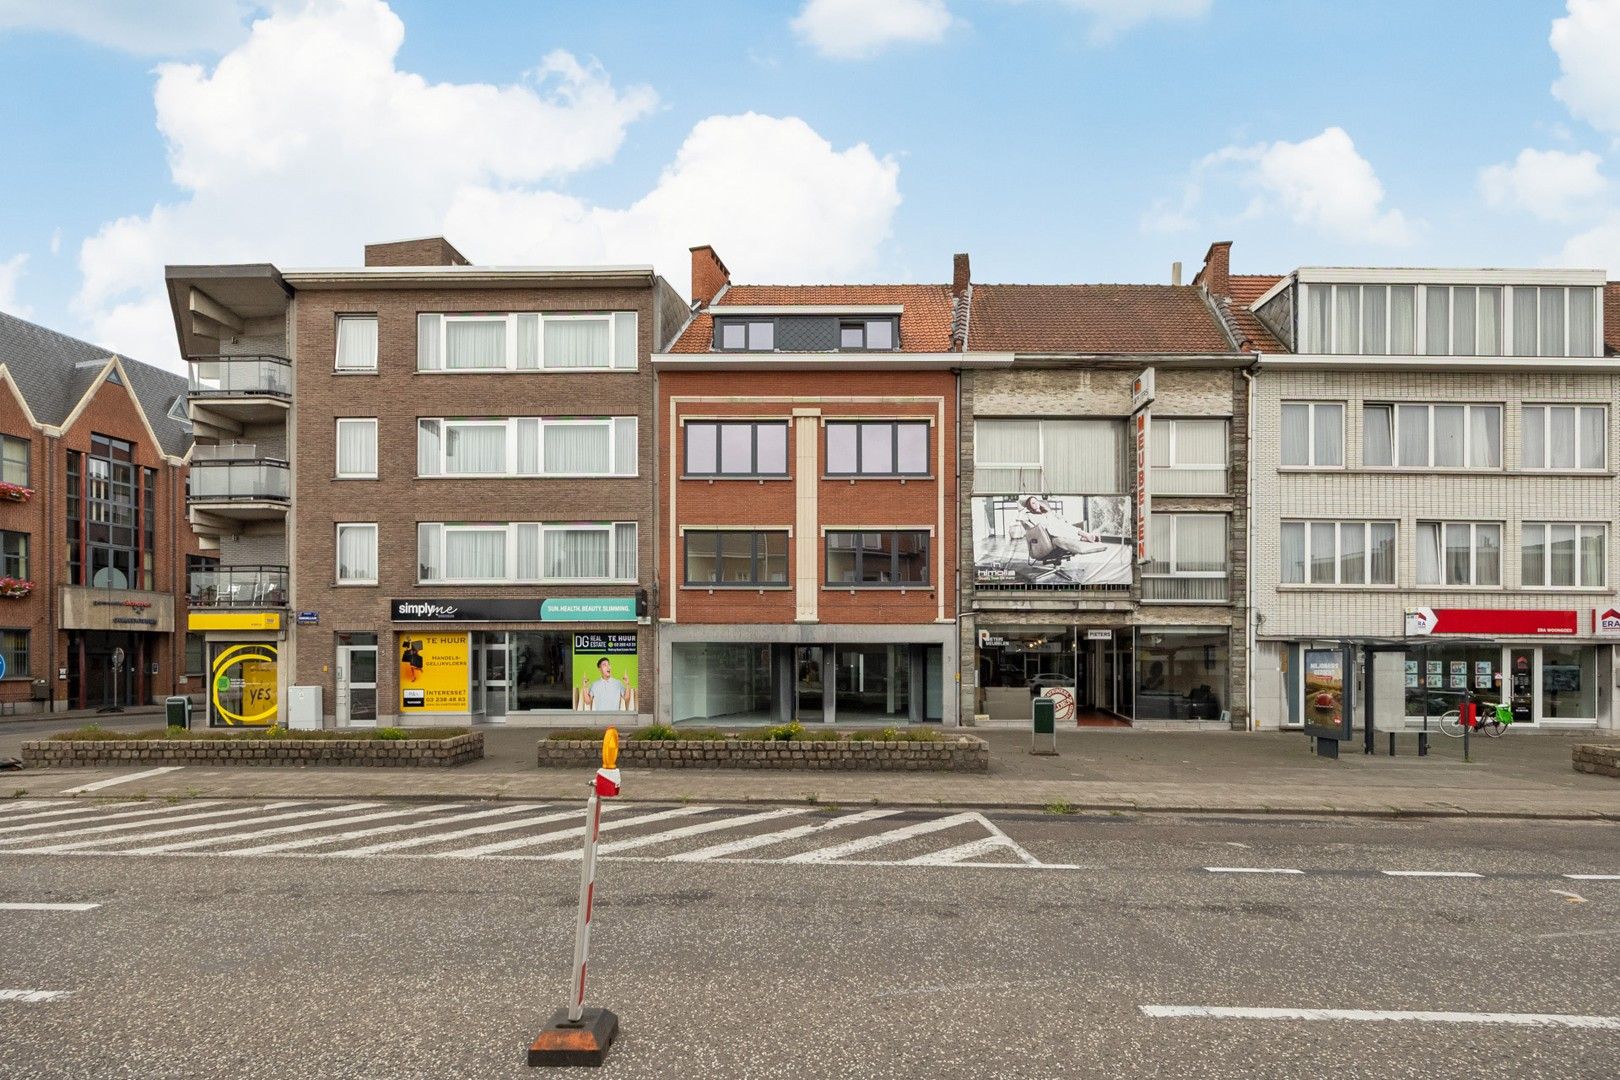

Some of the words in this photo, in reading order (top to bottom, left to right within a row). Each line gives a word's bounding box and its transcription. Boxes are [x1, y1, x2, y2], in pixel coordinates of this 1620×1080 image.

[1137, 415, 1145, 560] MEUBELEN
[398, 602, 458, 617] simplyme
[1602, 620, 1620, 628] ERA
[575, 636, 589, 648] DG
[249, 688, 271, 705] YES
